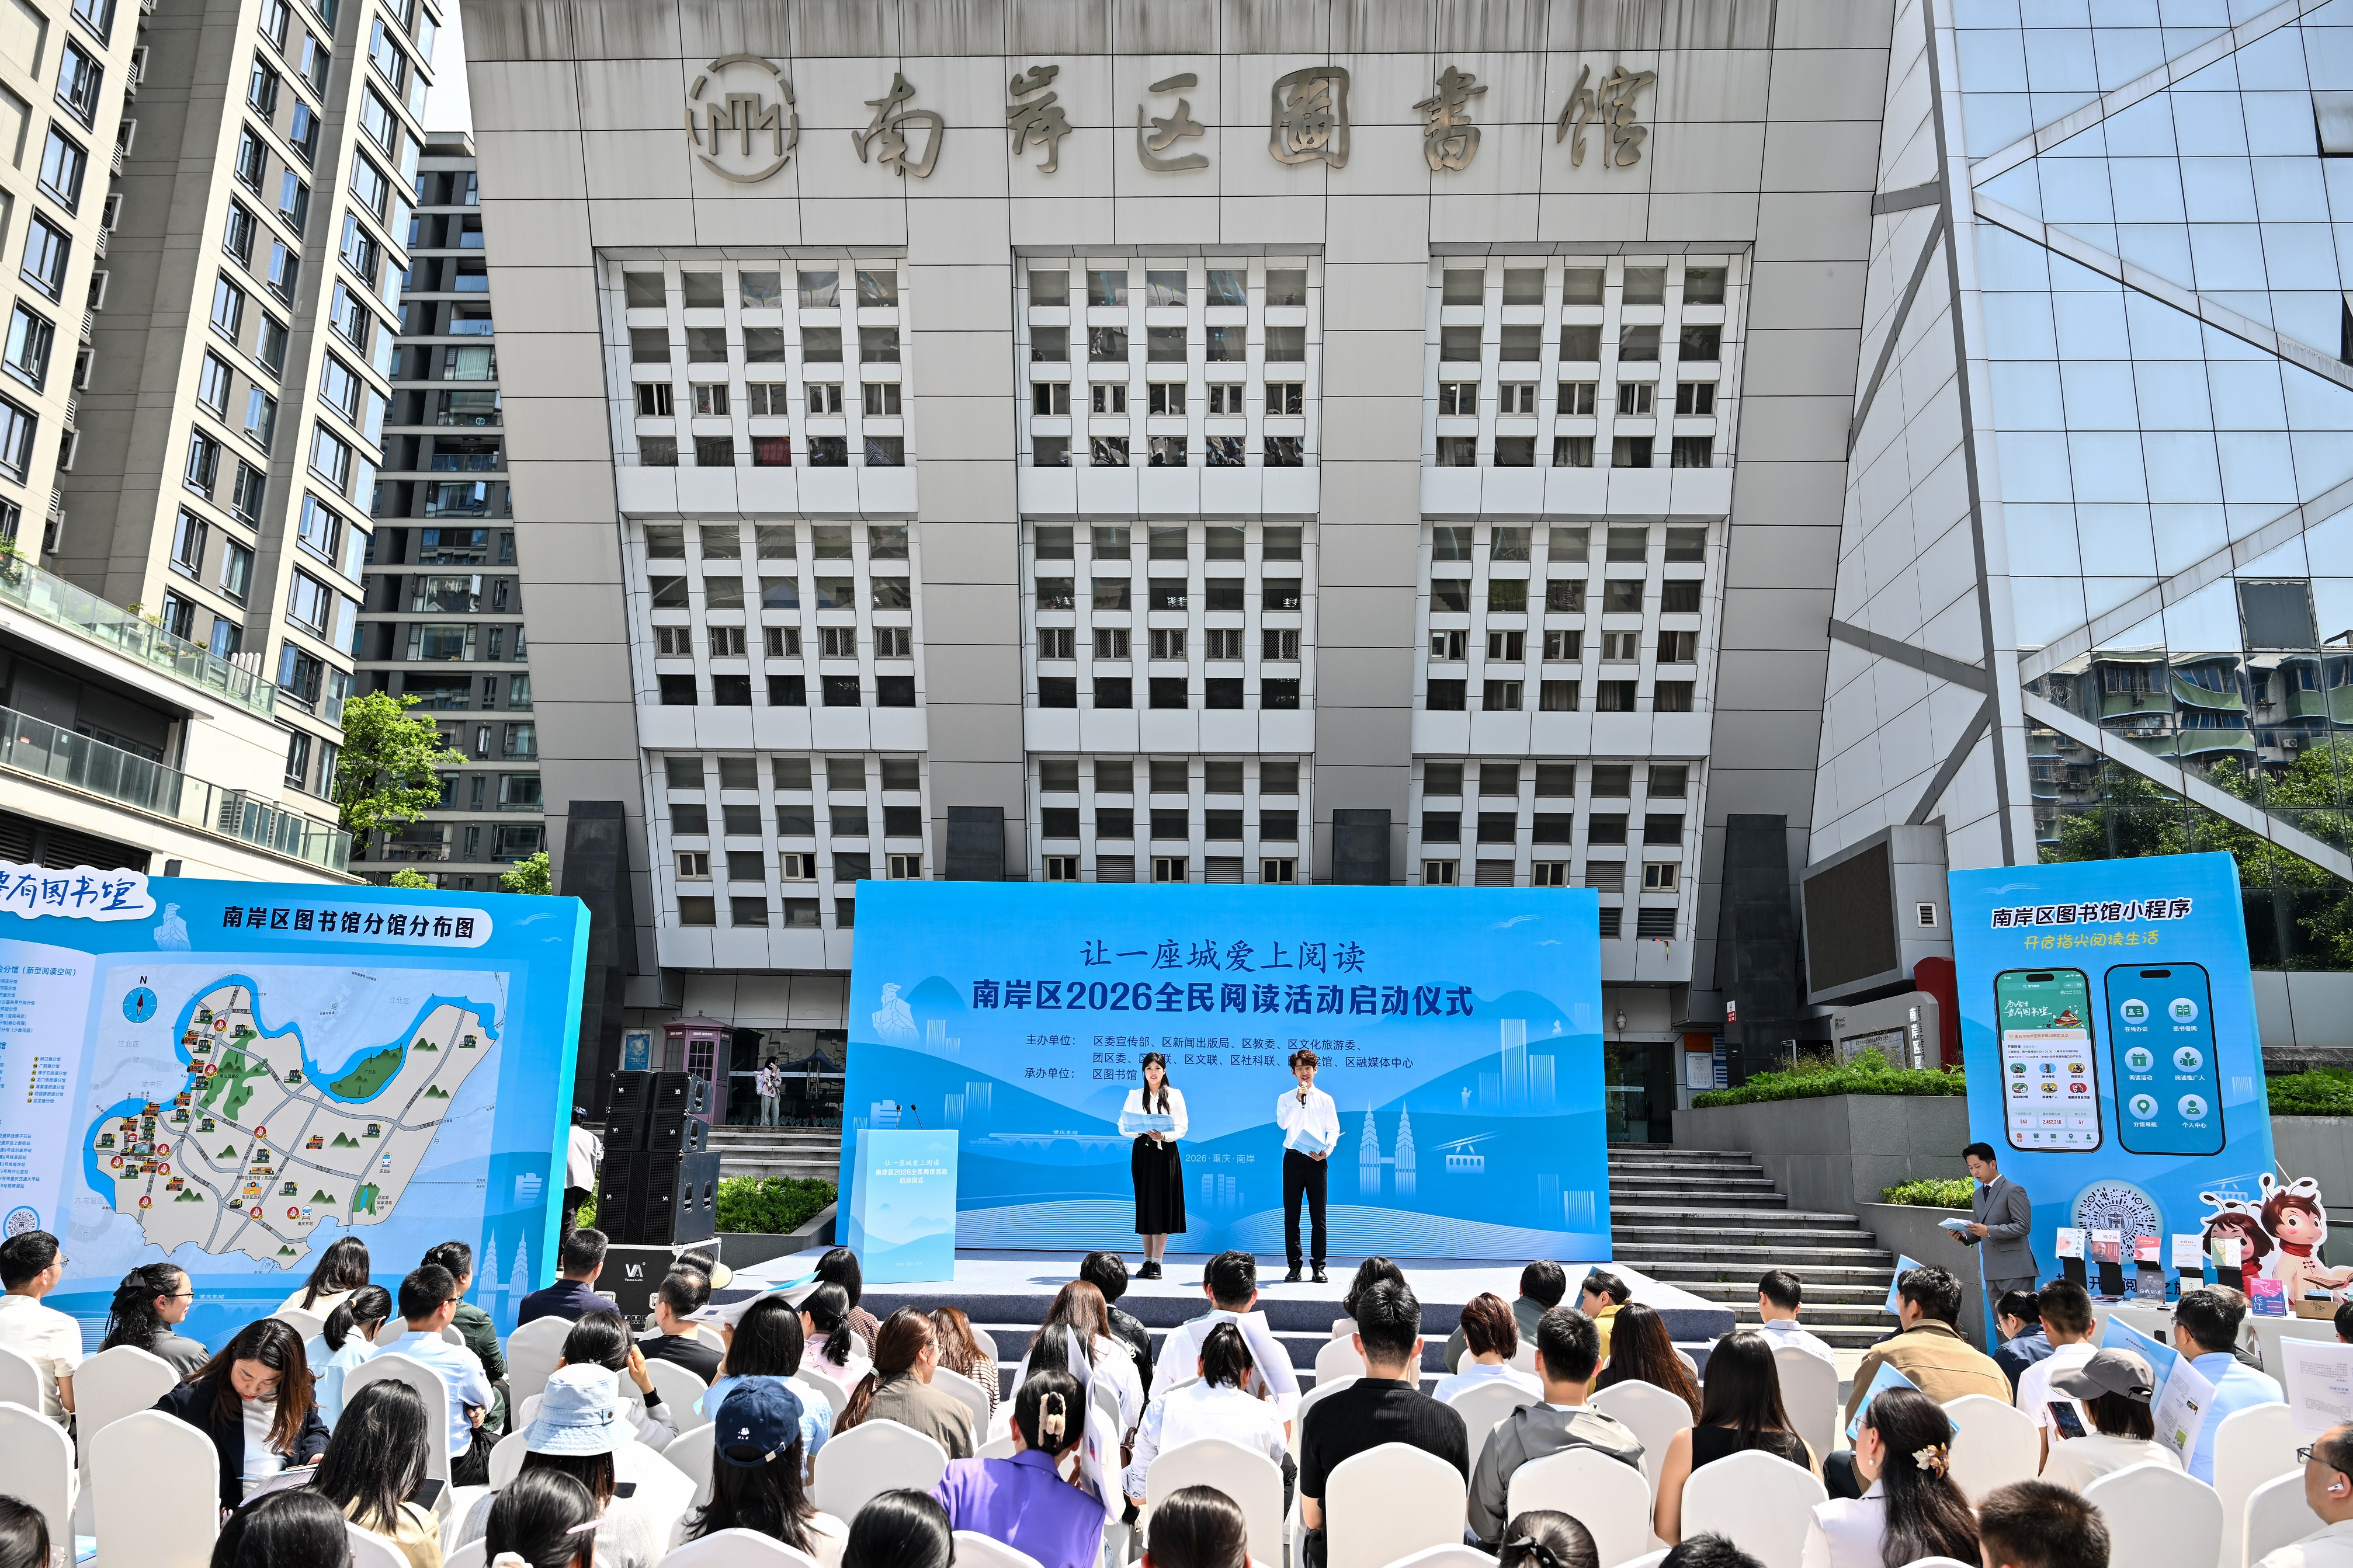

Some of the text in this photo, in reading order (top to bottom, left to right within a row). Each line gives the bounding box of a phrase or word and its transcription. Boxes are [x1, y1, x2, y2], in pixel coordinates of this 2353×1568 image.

[1993, 899, 2191, 927] 南岸区图书馆小程序
[223, 905, 474, 939] 南岸区图书馆分馆分布图
[2024, 930, 2159, 950] 开启指尖阅读生活
[1080, 938, 1366, 974] 让一座城爱上阅读
[140, 976, 147, 984] N
[973, 978, 1474, 1017] 南岸区2026全民阅读活动启动仪式
[2004, 1006, 2052, 1017] 要有图书馆
[1092, 1069, 1137, 1080] 区图书馆
[1185, 1153, 1255, 1163] 2026·重庆·南岸
[2254, 1296, 2264, 1310] 长江
